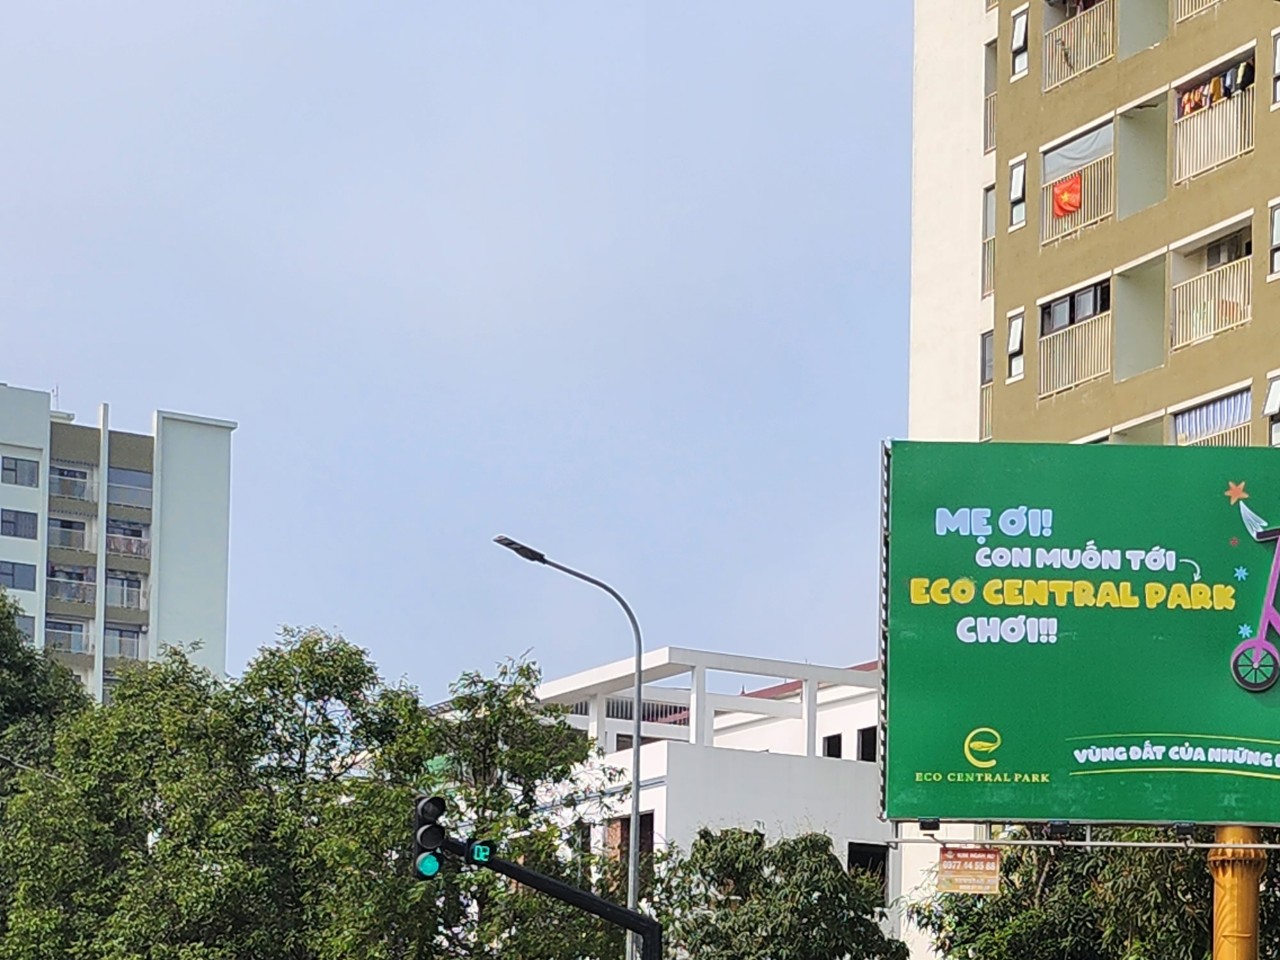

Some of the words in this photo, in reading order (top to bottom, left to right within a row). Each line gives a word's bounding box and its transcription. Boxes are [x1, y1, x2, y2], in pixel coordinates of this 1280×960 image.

[935, 507, 992, 544] MẸ
[998, 506, 1053, 537] ƠI!
[975, 547, 1031, 568] CON
[1036, 540, 1121, 570] MUỐN
[1125, 546, 1176, 571] TỚI
[910, 577, 976, 605] ECO
[983, 579, 1139, 608] CENTRAL
[1145, 582, 1236, 610] PARK
[956, 615, 1058, 643] CHƠI!!
[1073, 744, 1127, 763] VÙNG
[1129, 739, 1165, 761] ĐẤT
[1168, 742, 1205, 762] CỦA
[1208, 746, 1273, 767] NHỮNG
[915, 772, 943, 782] ECO
[947, 772, 1011, 782] CENTRAL
[1014, 773, 1050, 783] PARK
